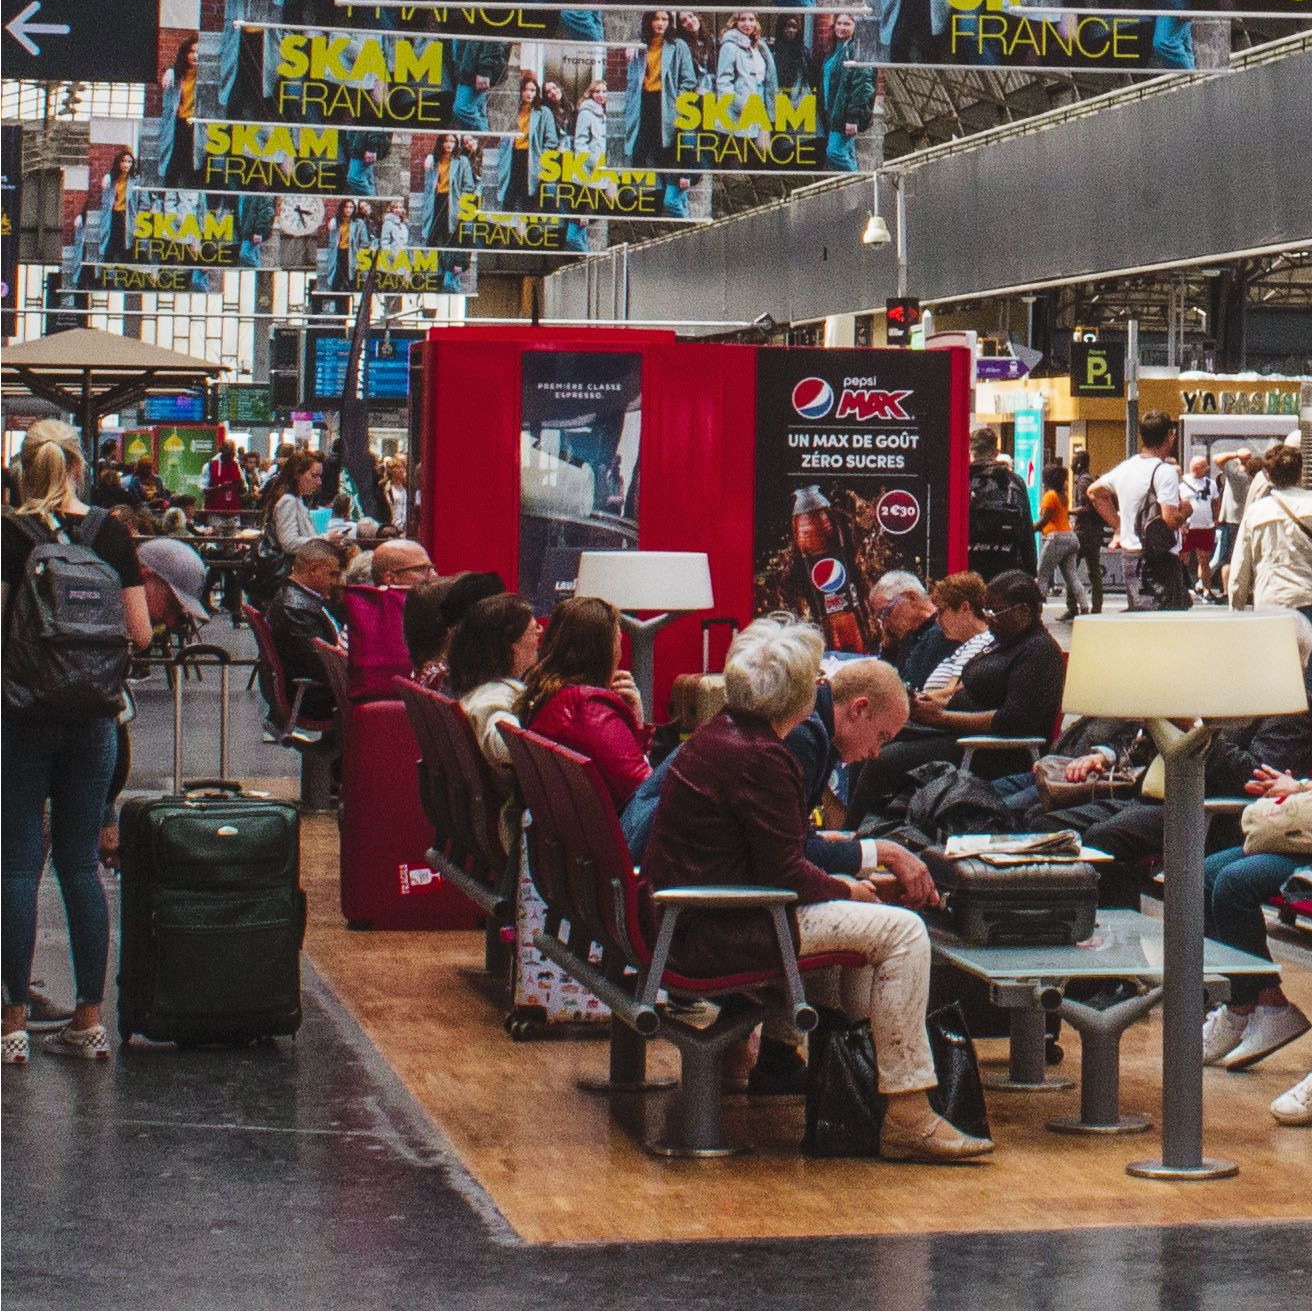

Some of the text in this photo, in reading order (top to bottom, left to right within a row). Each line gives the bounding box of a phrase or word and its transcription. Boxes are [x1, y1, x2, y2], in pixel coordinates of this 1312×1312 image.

[951, 15, 1140, 60] FRANCE
[277, 33, 444, 85] SKAM
[278, 82, 442, 122] FRANCE
[674, 91, 817, 132] SKAM
[205, 124, 339, 160] SKAM
[676, 133, 817, 165] FRANCE
[206, 157, 338, 189] FRANCE
[539, 183, 656, 212] FRANCE
[134, 211, 233, 241] SKAM
[457, 221, 559, 247] FRANCE
[134, 240, 232, 263] FRANCE
[102, 268, 186, 289] FRANCE
[843, 376, 877, 388] pepsi
[836, 389, 914, 421] MAX
[788, 431, 919, 449] UN MAX DE GOÛT
[801, 451, 905, 469] ZÉRO SUCRES
